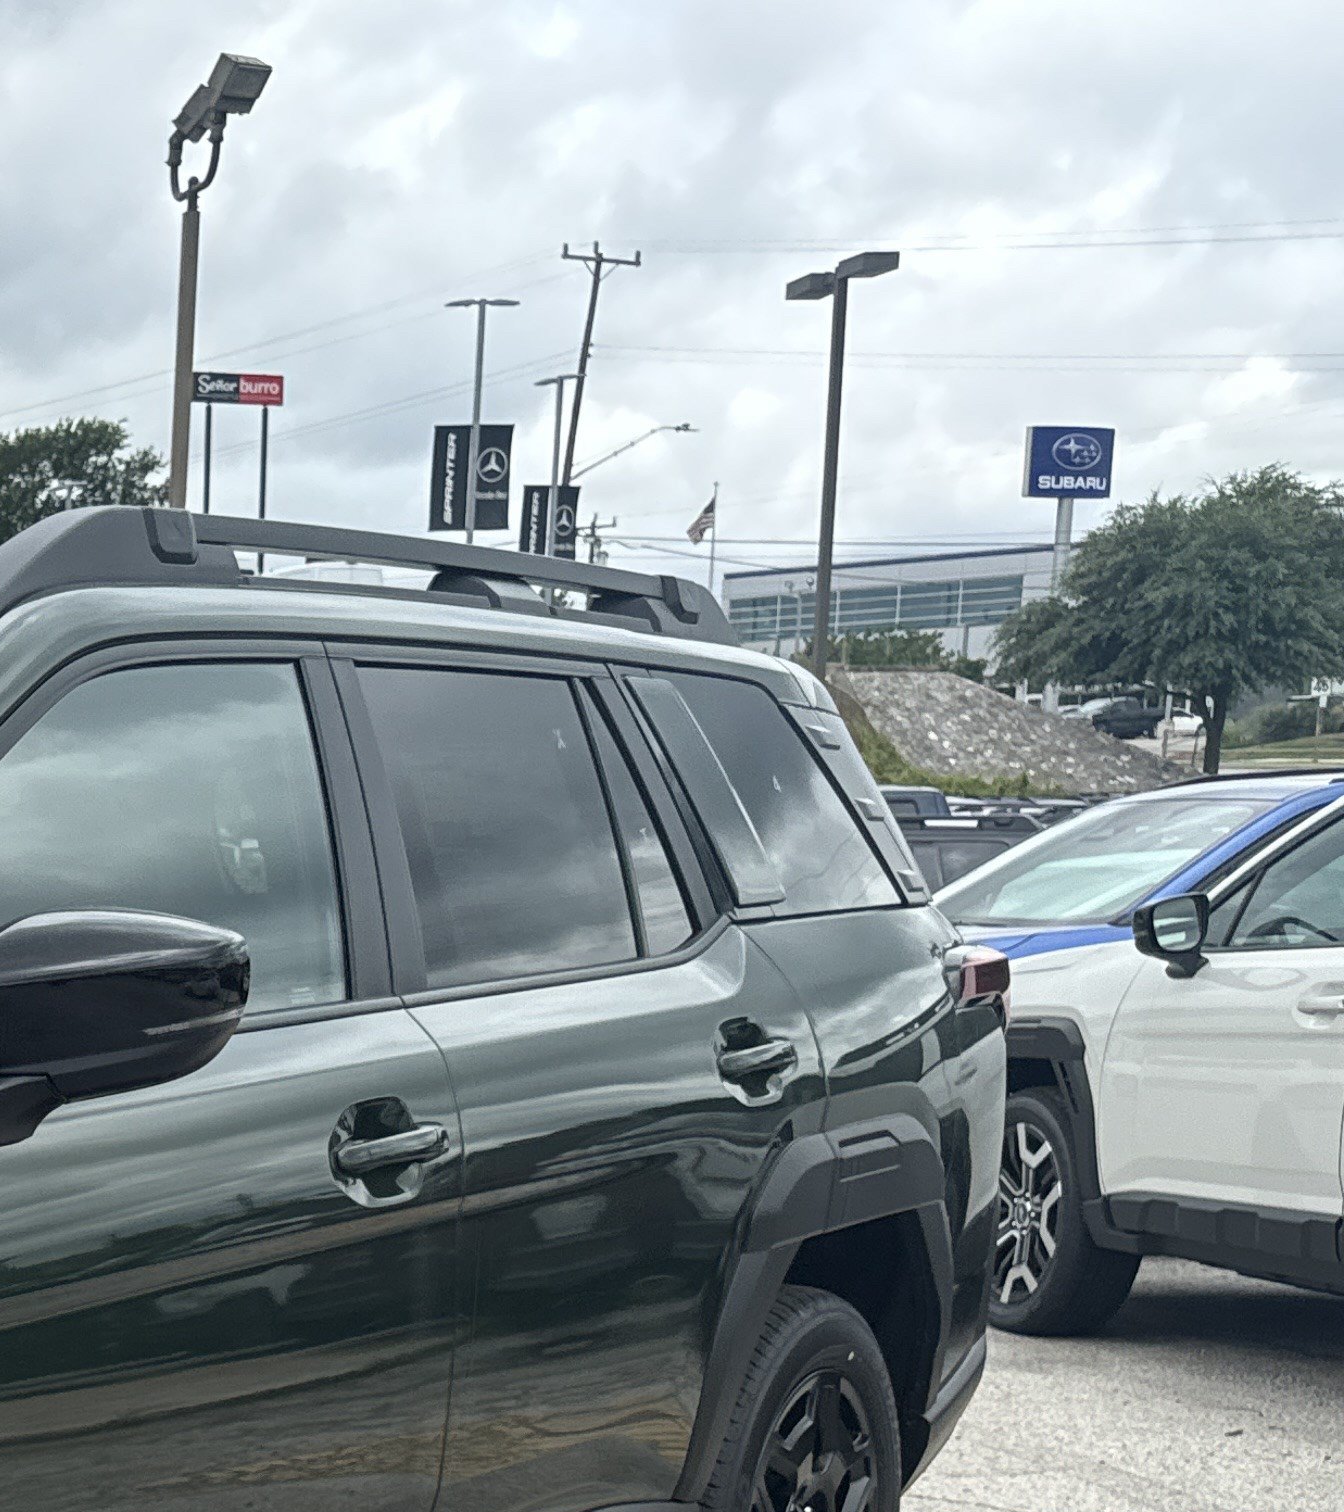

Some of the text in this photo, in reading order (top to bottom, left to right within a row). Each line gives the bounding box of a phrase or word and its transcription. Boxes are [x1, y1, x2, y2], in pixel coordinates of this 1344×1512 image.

[239, 378, 280, 395] burro
[443, 432, 457, 525] SPRINTER
[1037, 474, 1108, 492] SUBARU
